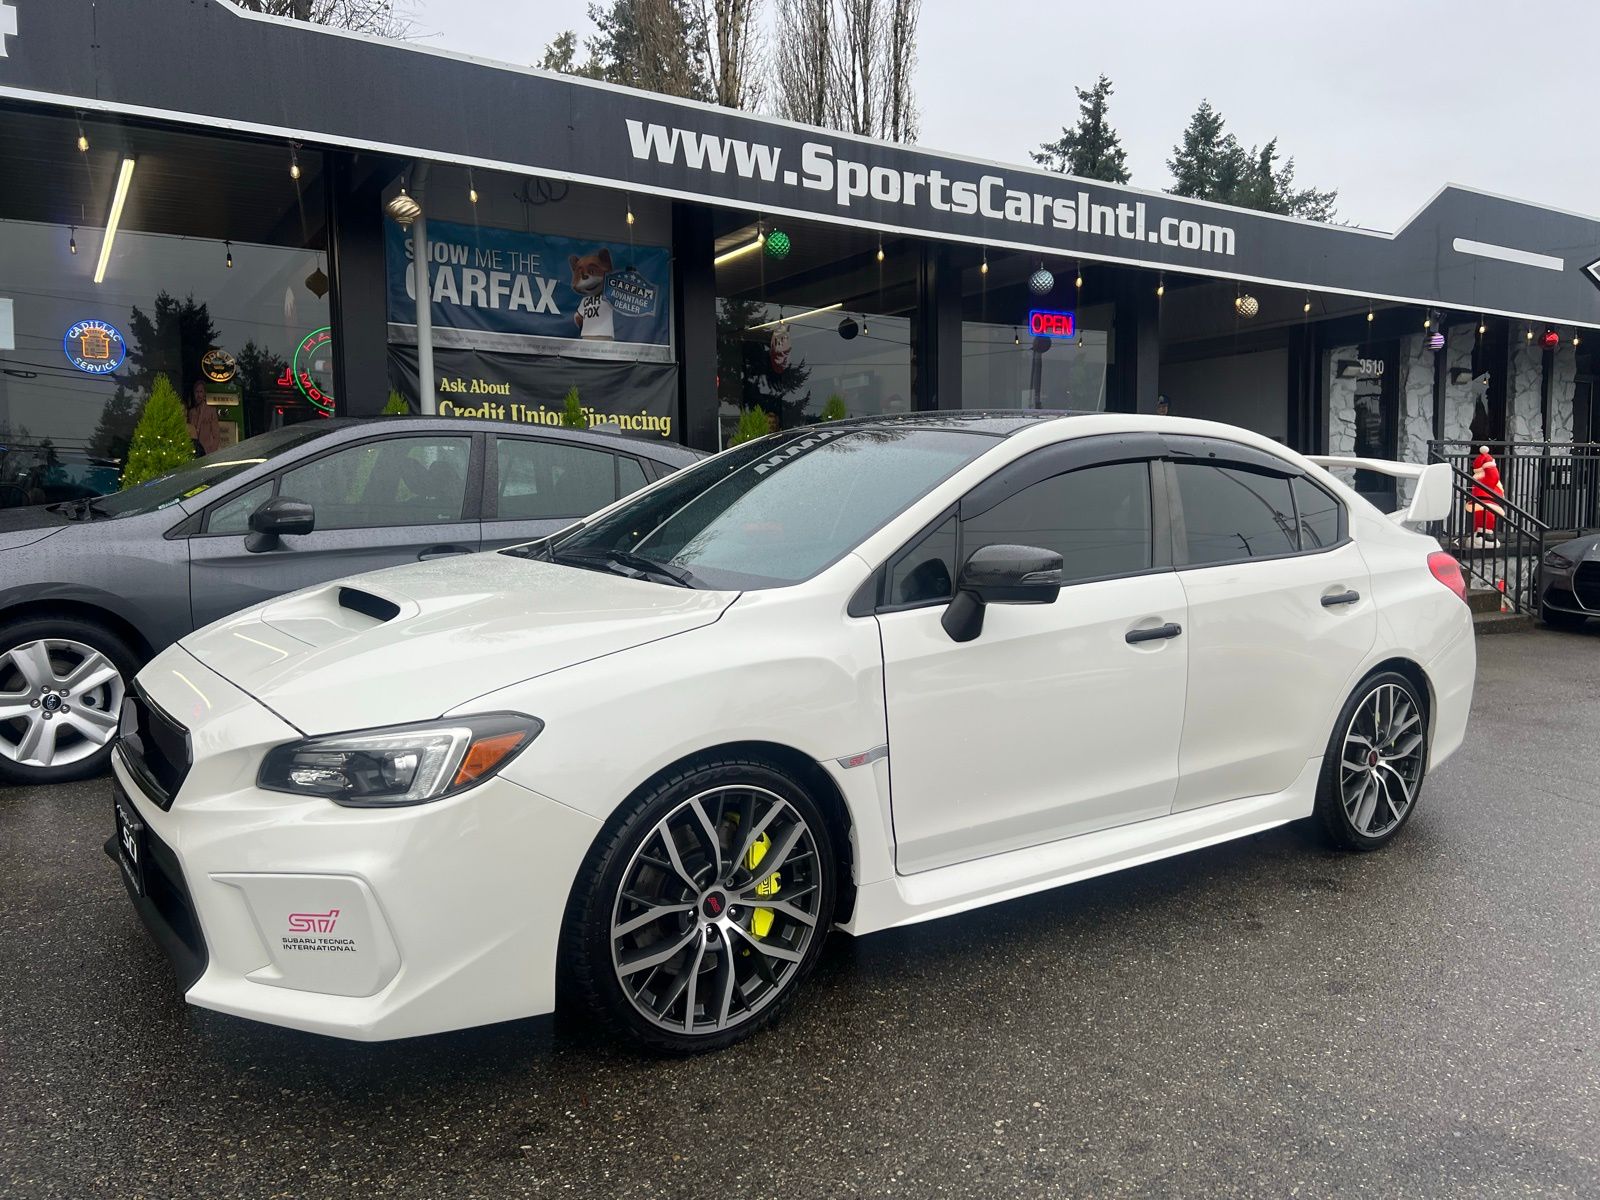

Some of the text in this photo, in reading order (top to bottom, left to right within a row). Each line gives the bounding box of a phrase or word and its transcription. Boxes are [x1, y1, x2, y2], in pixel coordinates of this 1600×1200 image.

[625, 118, 1236, 255] www.SportsCarsIntl.com
[475, 248, 504, 270] ME
[507, 251, 541, 275] THE
[609, 279, 653, 299] CARFAX
[610, 289, 649, 308] ADVANTAGE
[583, 294, 601, 308] CAR
[614, 300, 640, 314] DEALER
[583, 306, 600, 319] FOX
[69, 321, 121, 342] CADILLAC
[1031, 313, 1072, 335] OPEN
[74, 357, 118, 372] SERVICE
[440, 377, 511, 395] Ask About
[439, 400, 506, 420] Credit
[283, 944, 357, 952] INTERNATIONAL
